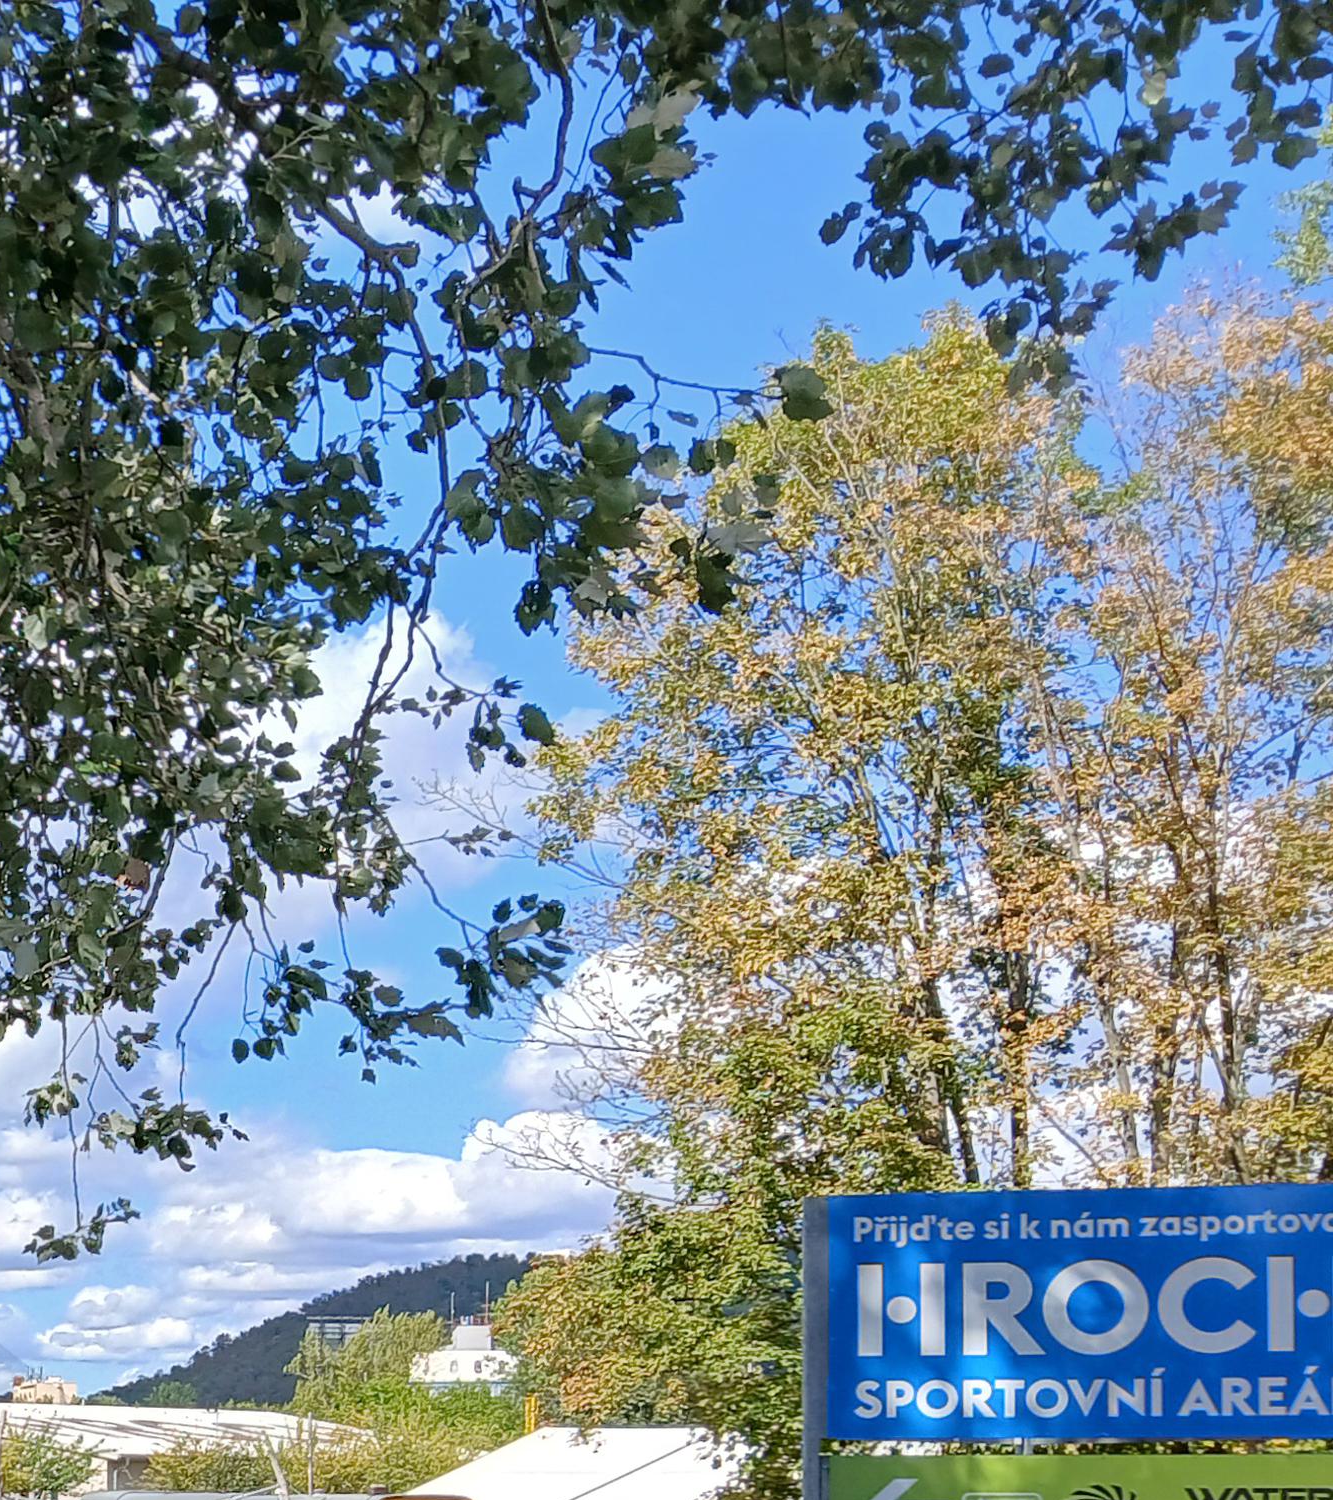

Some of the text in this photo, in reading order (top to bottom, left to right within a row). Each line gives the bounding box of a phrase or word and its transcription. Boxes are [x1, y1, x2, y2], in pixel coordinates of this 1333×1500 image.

[853, 1214, 975, 1248] Přijďte
[983, 1212, 1009, 1240] si
[1020, 1213, 1041, 1239] k
[1050, 1211, 1130, 1238] nám
[854, 1366, 1333, 1419] SPORTOVNÍ AREÁ
